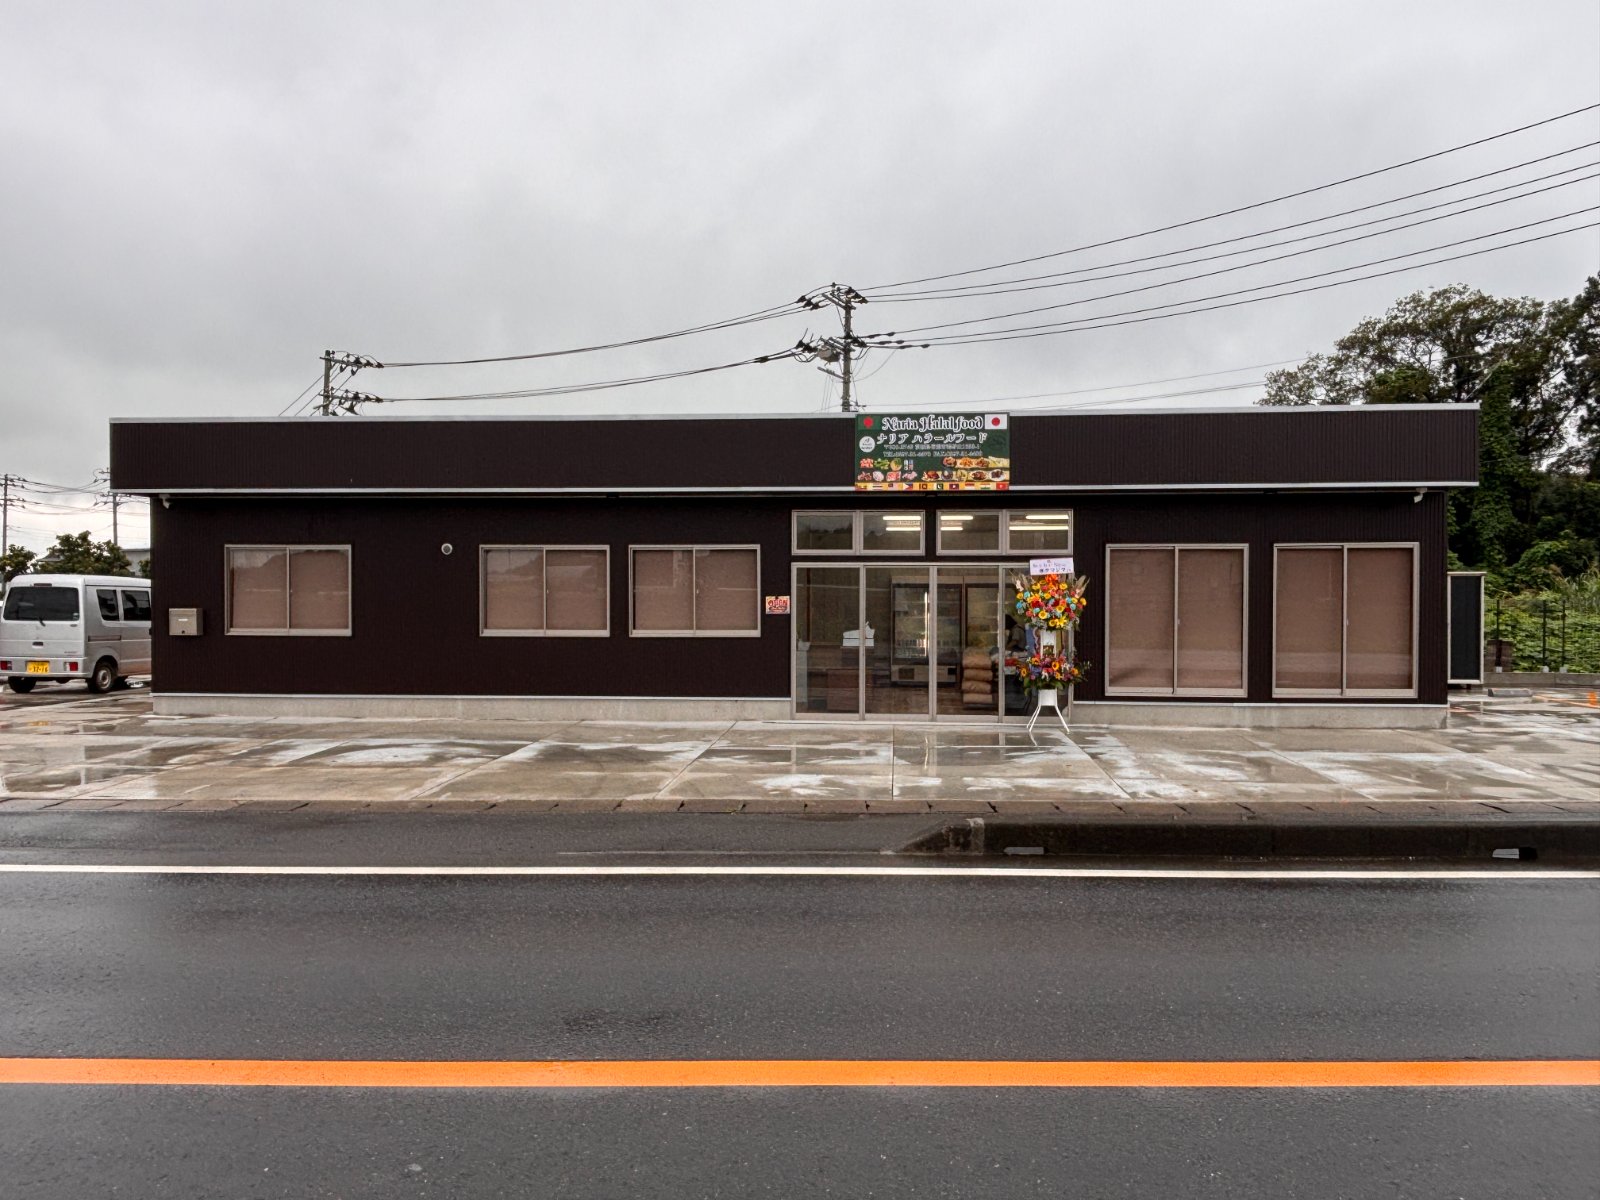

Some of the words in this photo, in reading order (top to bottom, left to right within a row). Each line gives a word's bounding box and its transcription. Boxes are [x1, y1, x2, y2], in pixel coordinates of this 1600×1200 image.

[918, 414, 954, 432] Halal
[953, 415, 984, 432] food
[876, 433, 909, 445] ナリア
[911, 432, 988, 444] ハラールフード
